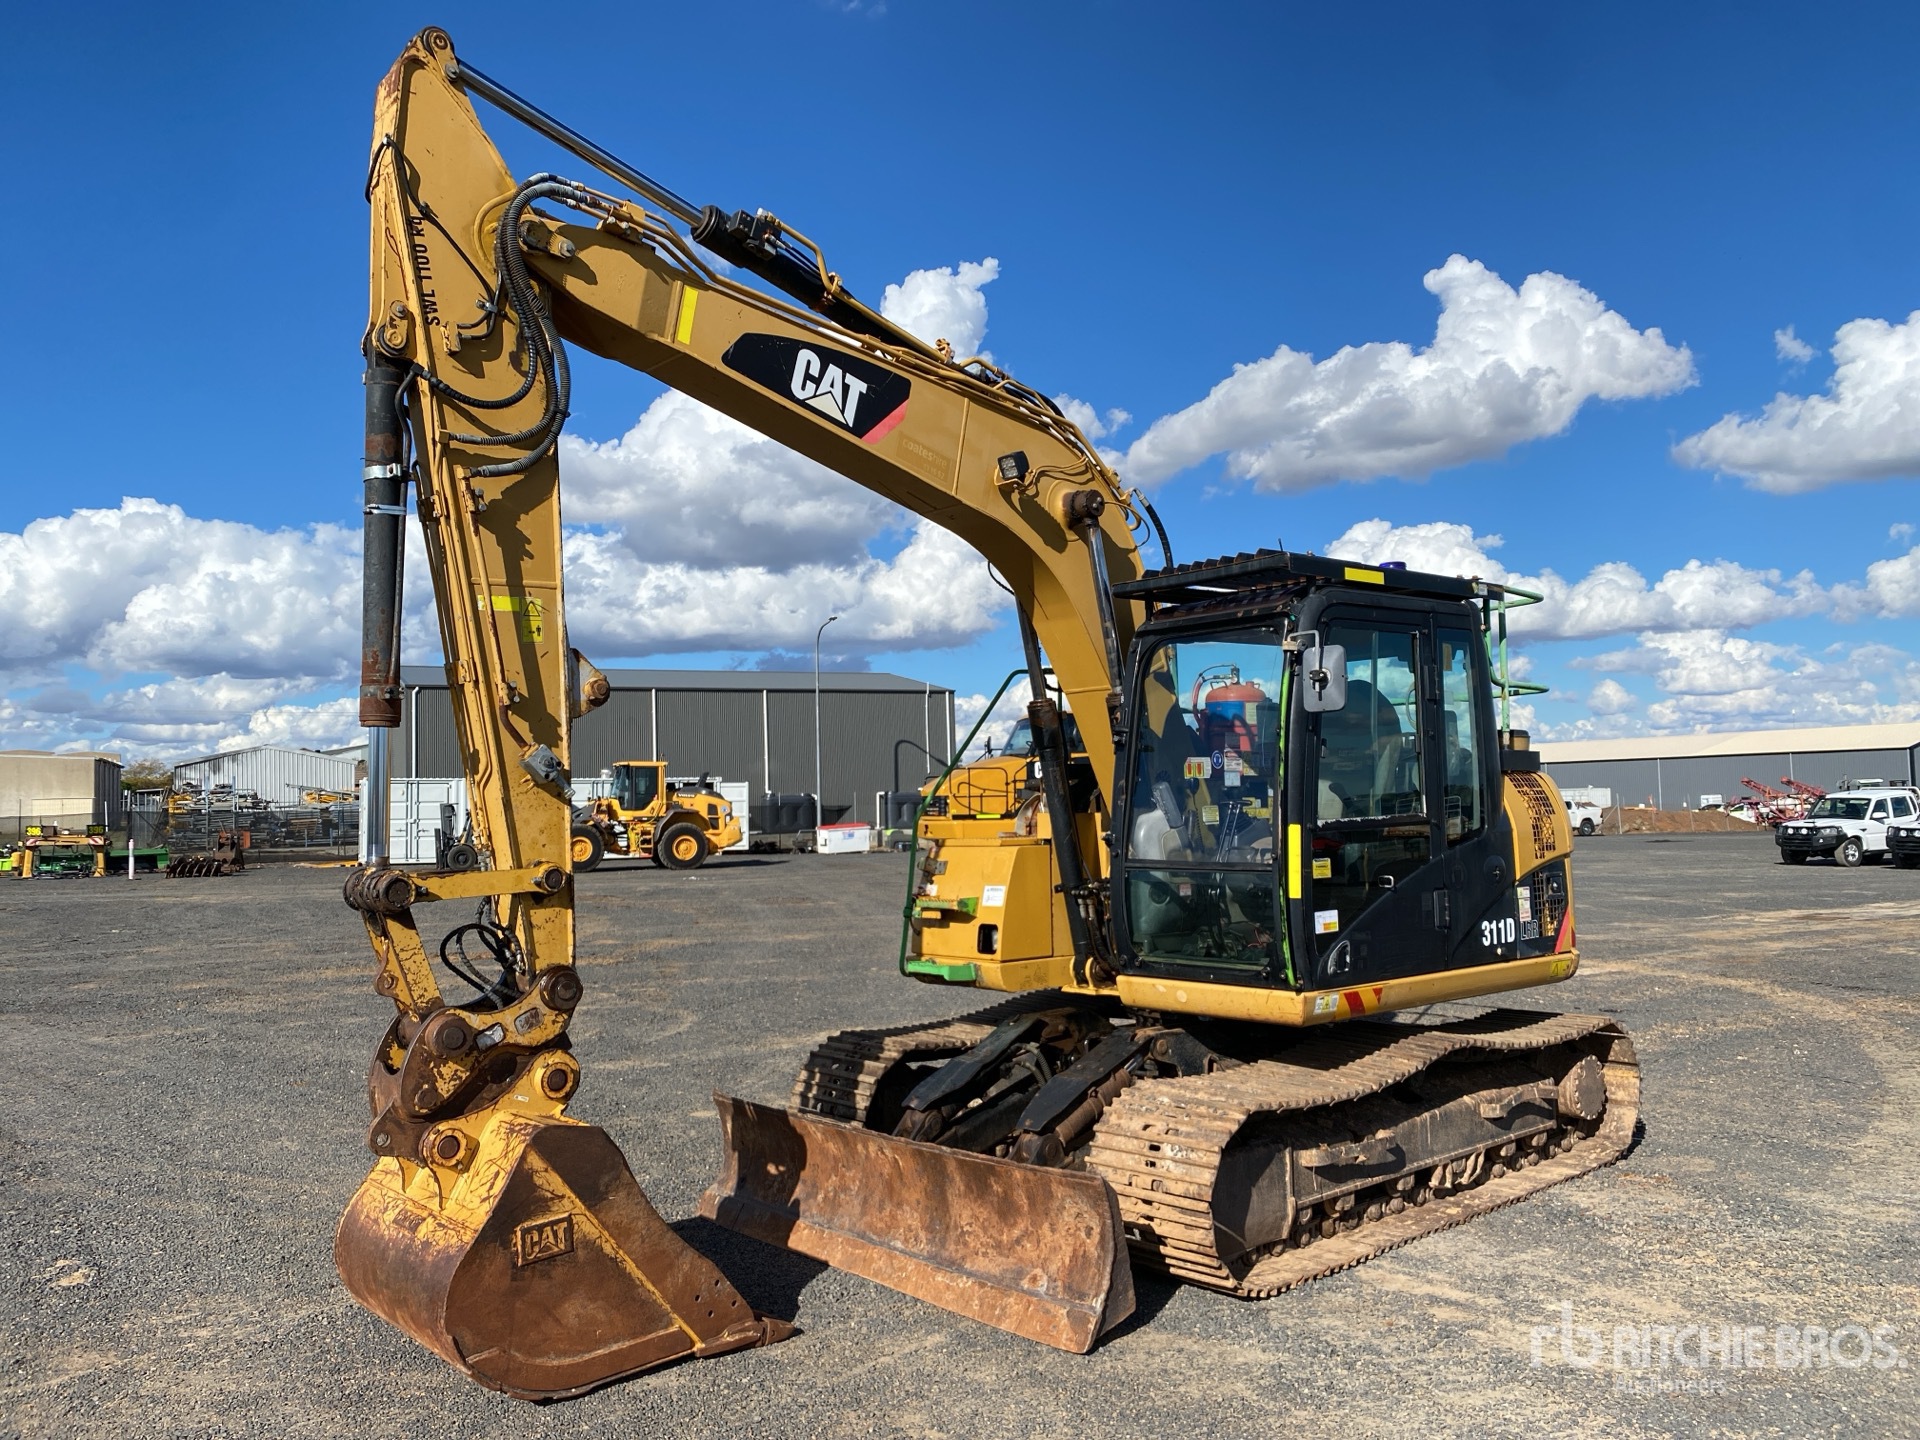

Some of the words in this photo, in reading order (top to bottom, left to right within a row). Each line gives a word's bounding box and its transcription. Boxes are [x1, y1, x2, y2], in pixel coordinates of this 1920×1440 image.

[413, 243, 432, 280] 1100
[421, 289, 440, 326] SWL
[790, 348, 868, 428] CAT
[26, 827, 41, 836] 396
[88, 826, 103, 834] 396
[1481, 917, 1516, 947] 311D
[525, 1221, 568, 1260] CAT
